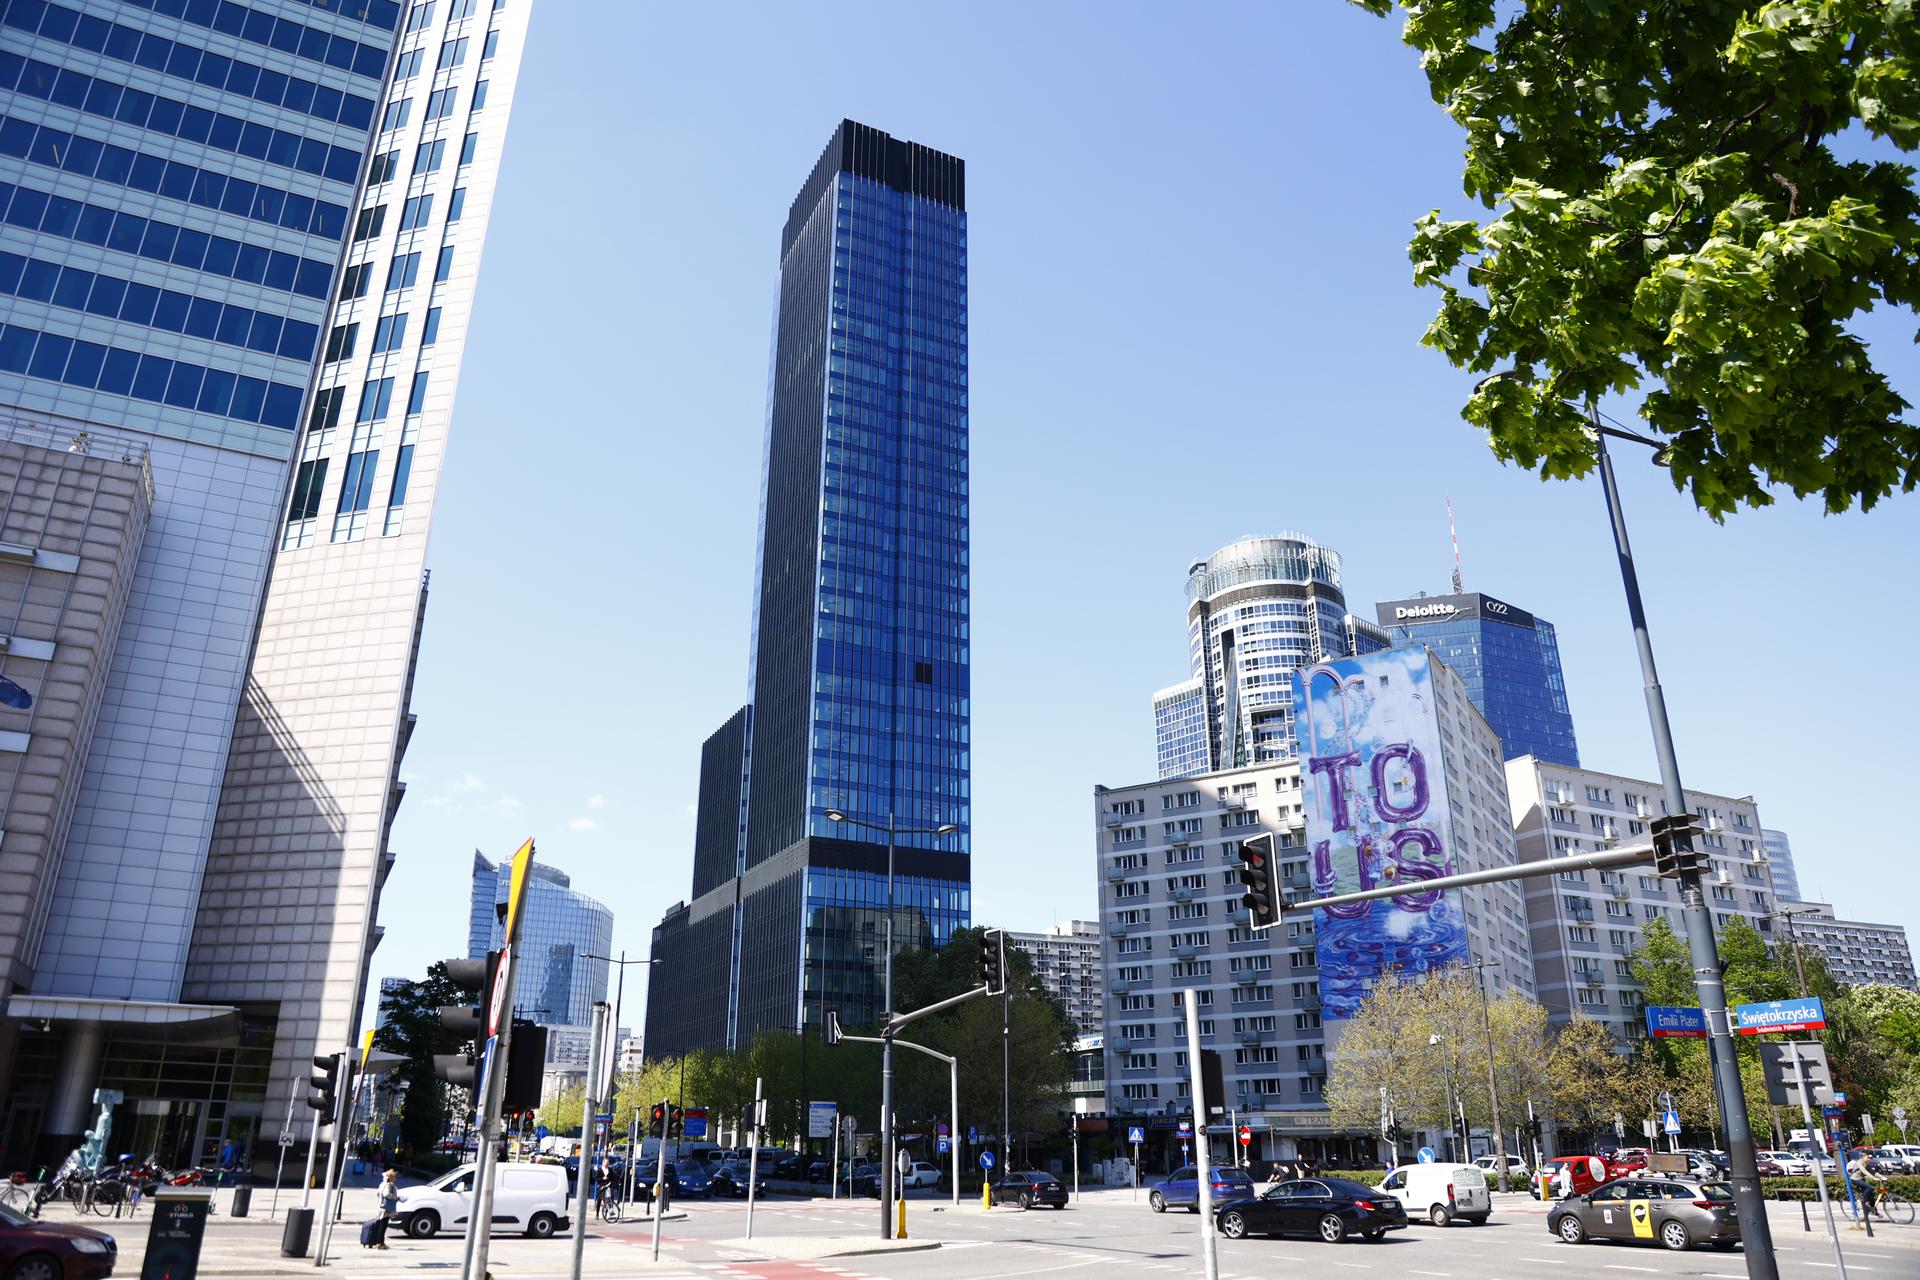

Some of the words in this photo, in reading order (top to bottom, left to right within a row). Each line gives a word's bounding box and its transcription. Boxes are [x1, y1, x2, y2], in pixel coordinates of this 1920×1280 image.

[1658, 1014, 1678, 1026] Emilii
[1680, 1015, 1699, 1027] Plater
[1742, 1006, 1817, 1026] Świętokrzyska
[940, 1142, 947, 1151] P
